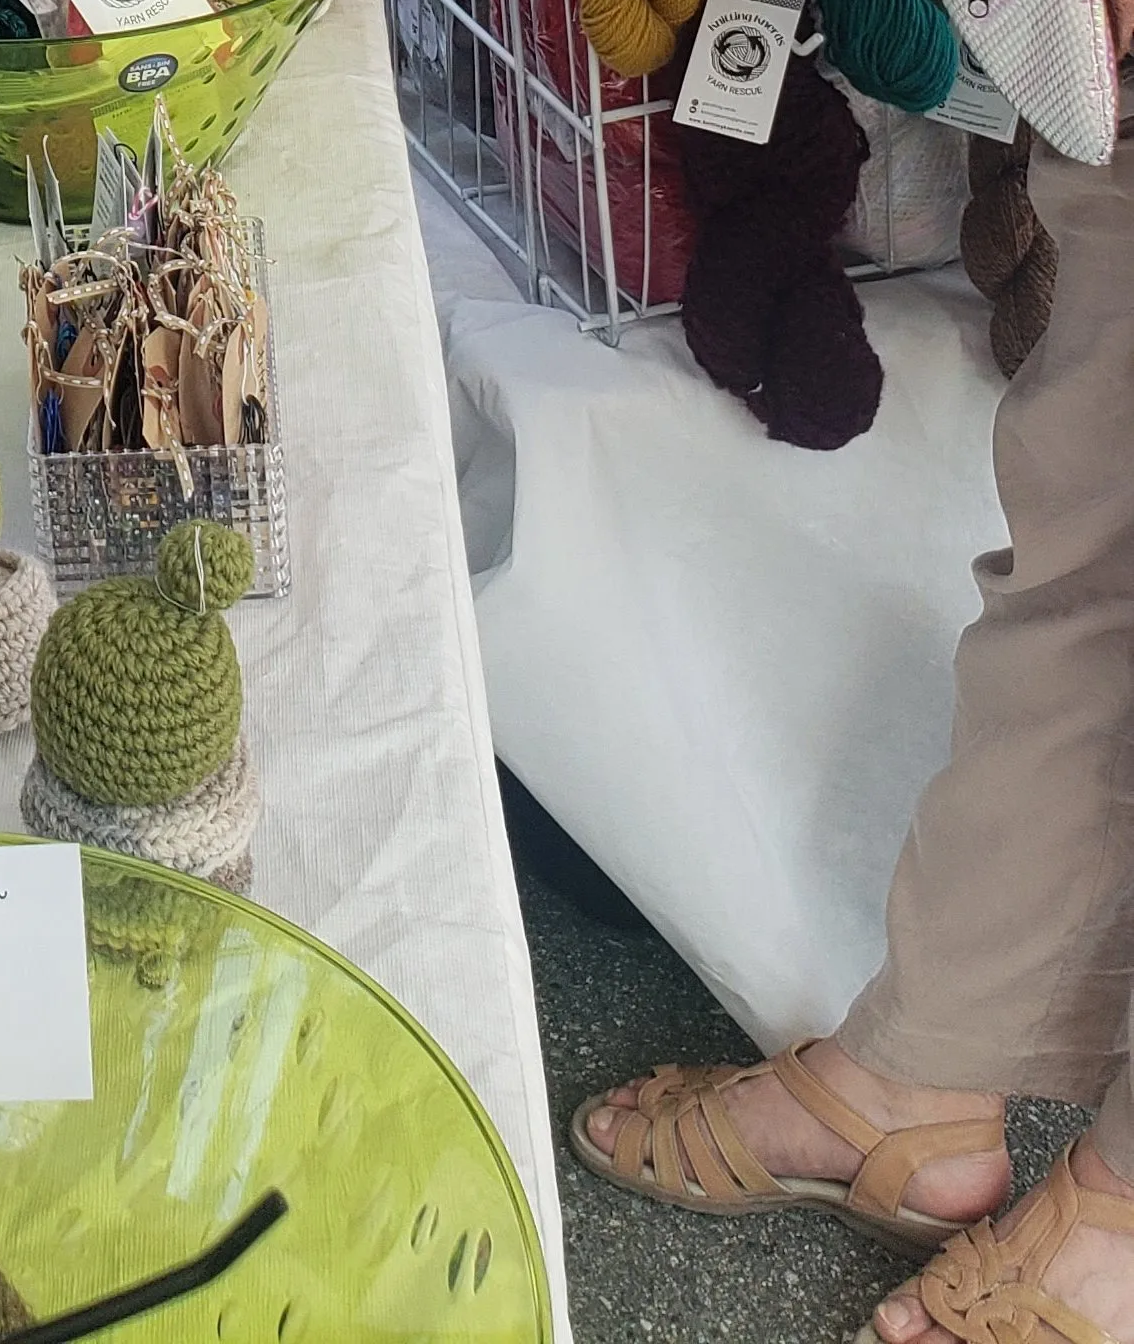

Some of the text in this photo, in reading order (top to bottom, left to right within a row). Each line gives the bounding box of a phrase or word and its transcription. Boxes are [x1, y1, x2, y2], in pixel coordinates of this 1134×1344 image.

[115, 14, 146, 27] YARN
[707, 11, 786, 48] Knitting Knerds
[126, 66, 172, 84] BPA
[136, 78, 156, 87] FREE
[705, 74, 763, 95] YARN RESCUE
